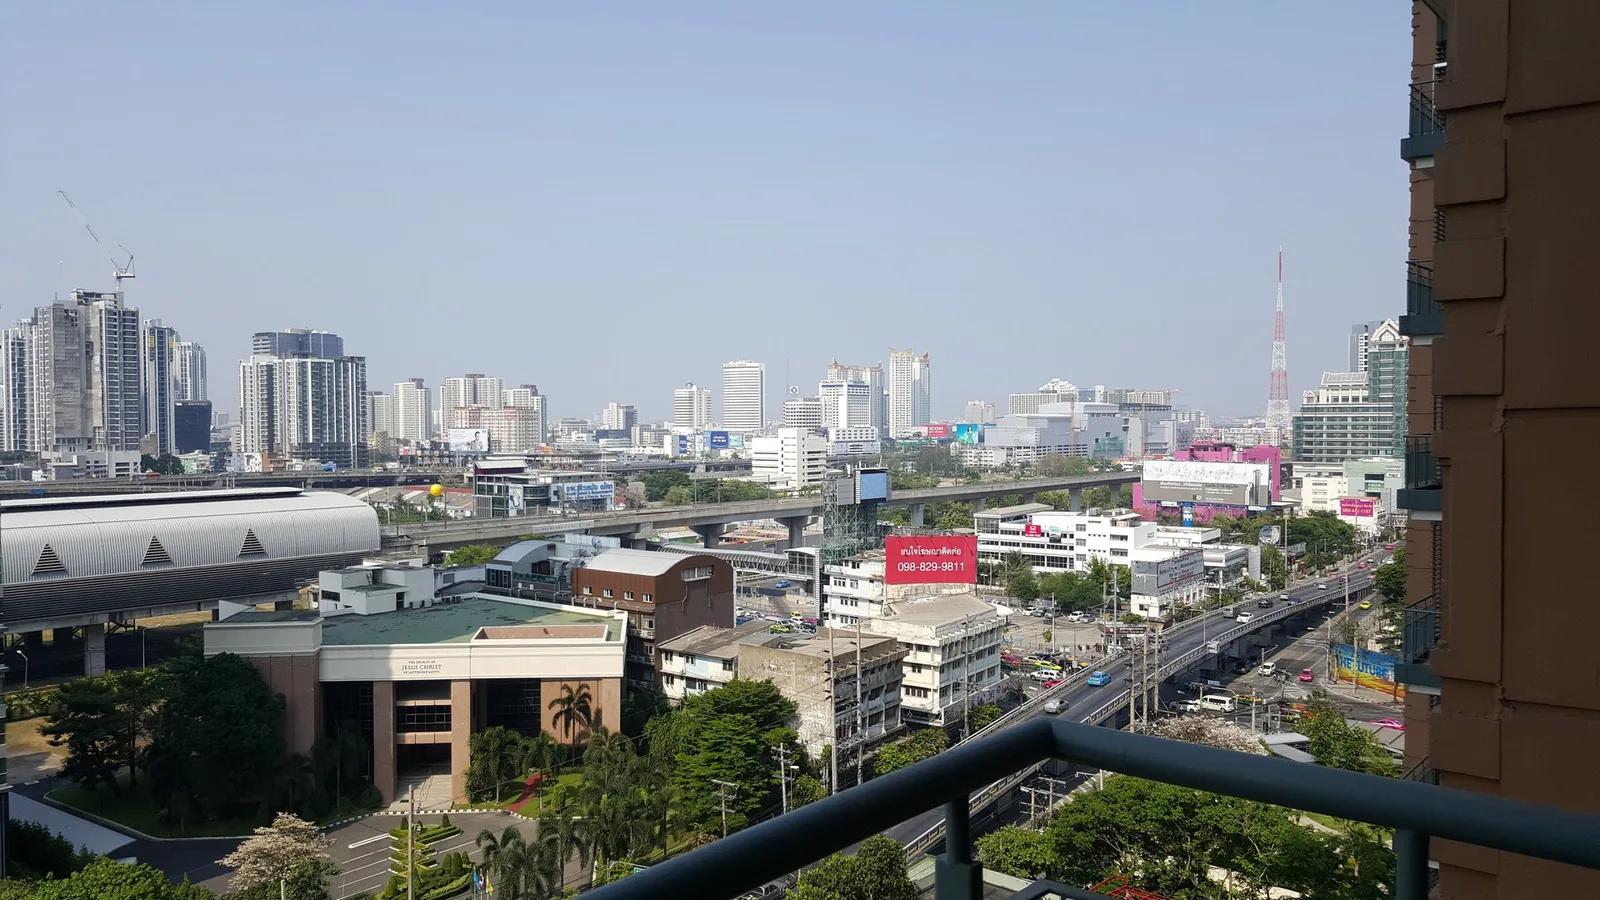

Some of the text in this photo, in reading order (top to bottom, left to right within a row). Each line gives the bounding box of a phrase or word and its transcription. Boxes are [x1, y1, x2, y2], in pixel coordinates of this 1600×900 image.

[901, 545, 961, 556] สนใจโฆษณาติดต่อ
[897, 562, 964, 571] 098-829-9811
